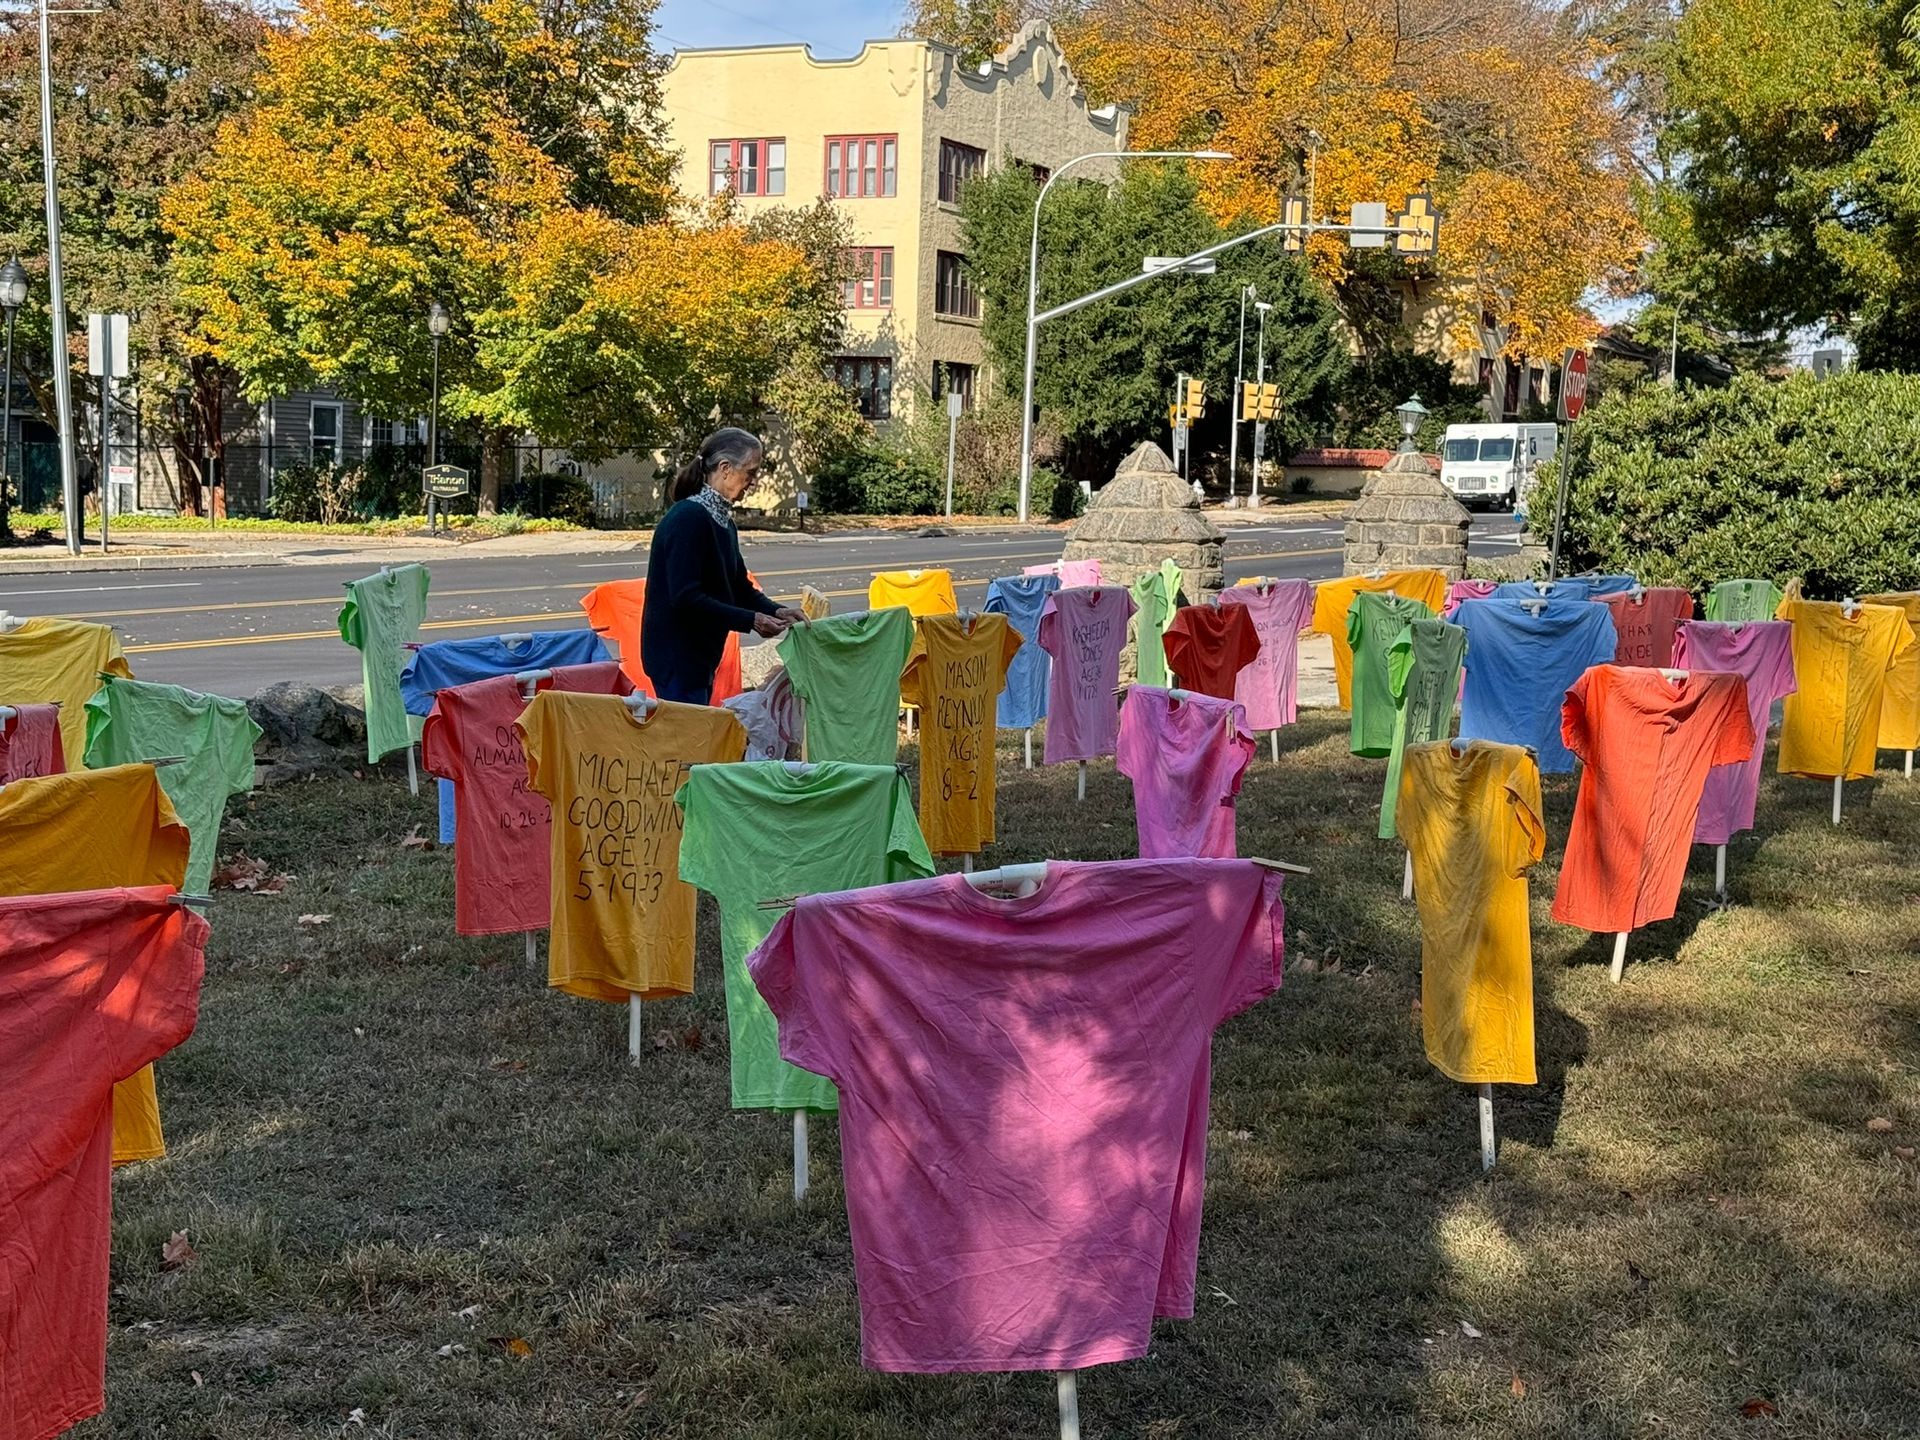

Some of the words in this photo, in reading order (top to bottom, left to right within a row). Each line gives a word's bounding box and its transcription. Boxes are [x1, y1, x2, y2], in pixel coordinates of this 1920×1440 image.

[1567, 370, 1586, 399] STOP
[945, 652, 988, 690] MASON
[568, 796, 685, 834] GOODWIN
[578, 833, 636, 867] AGE
